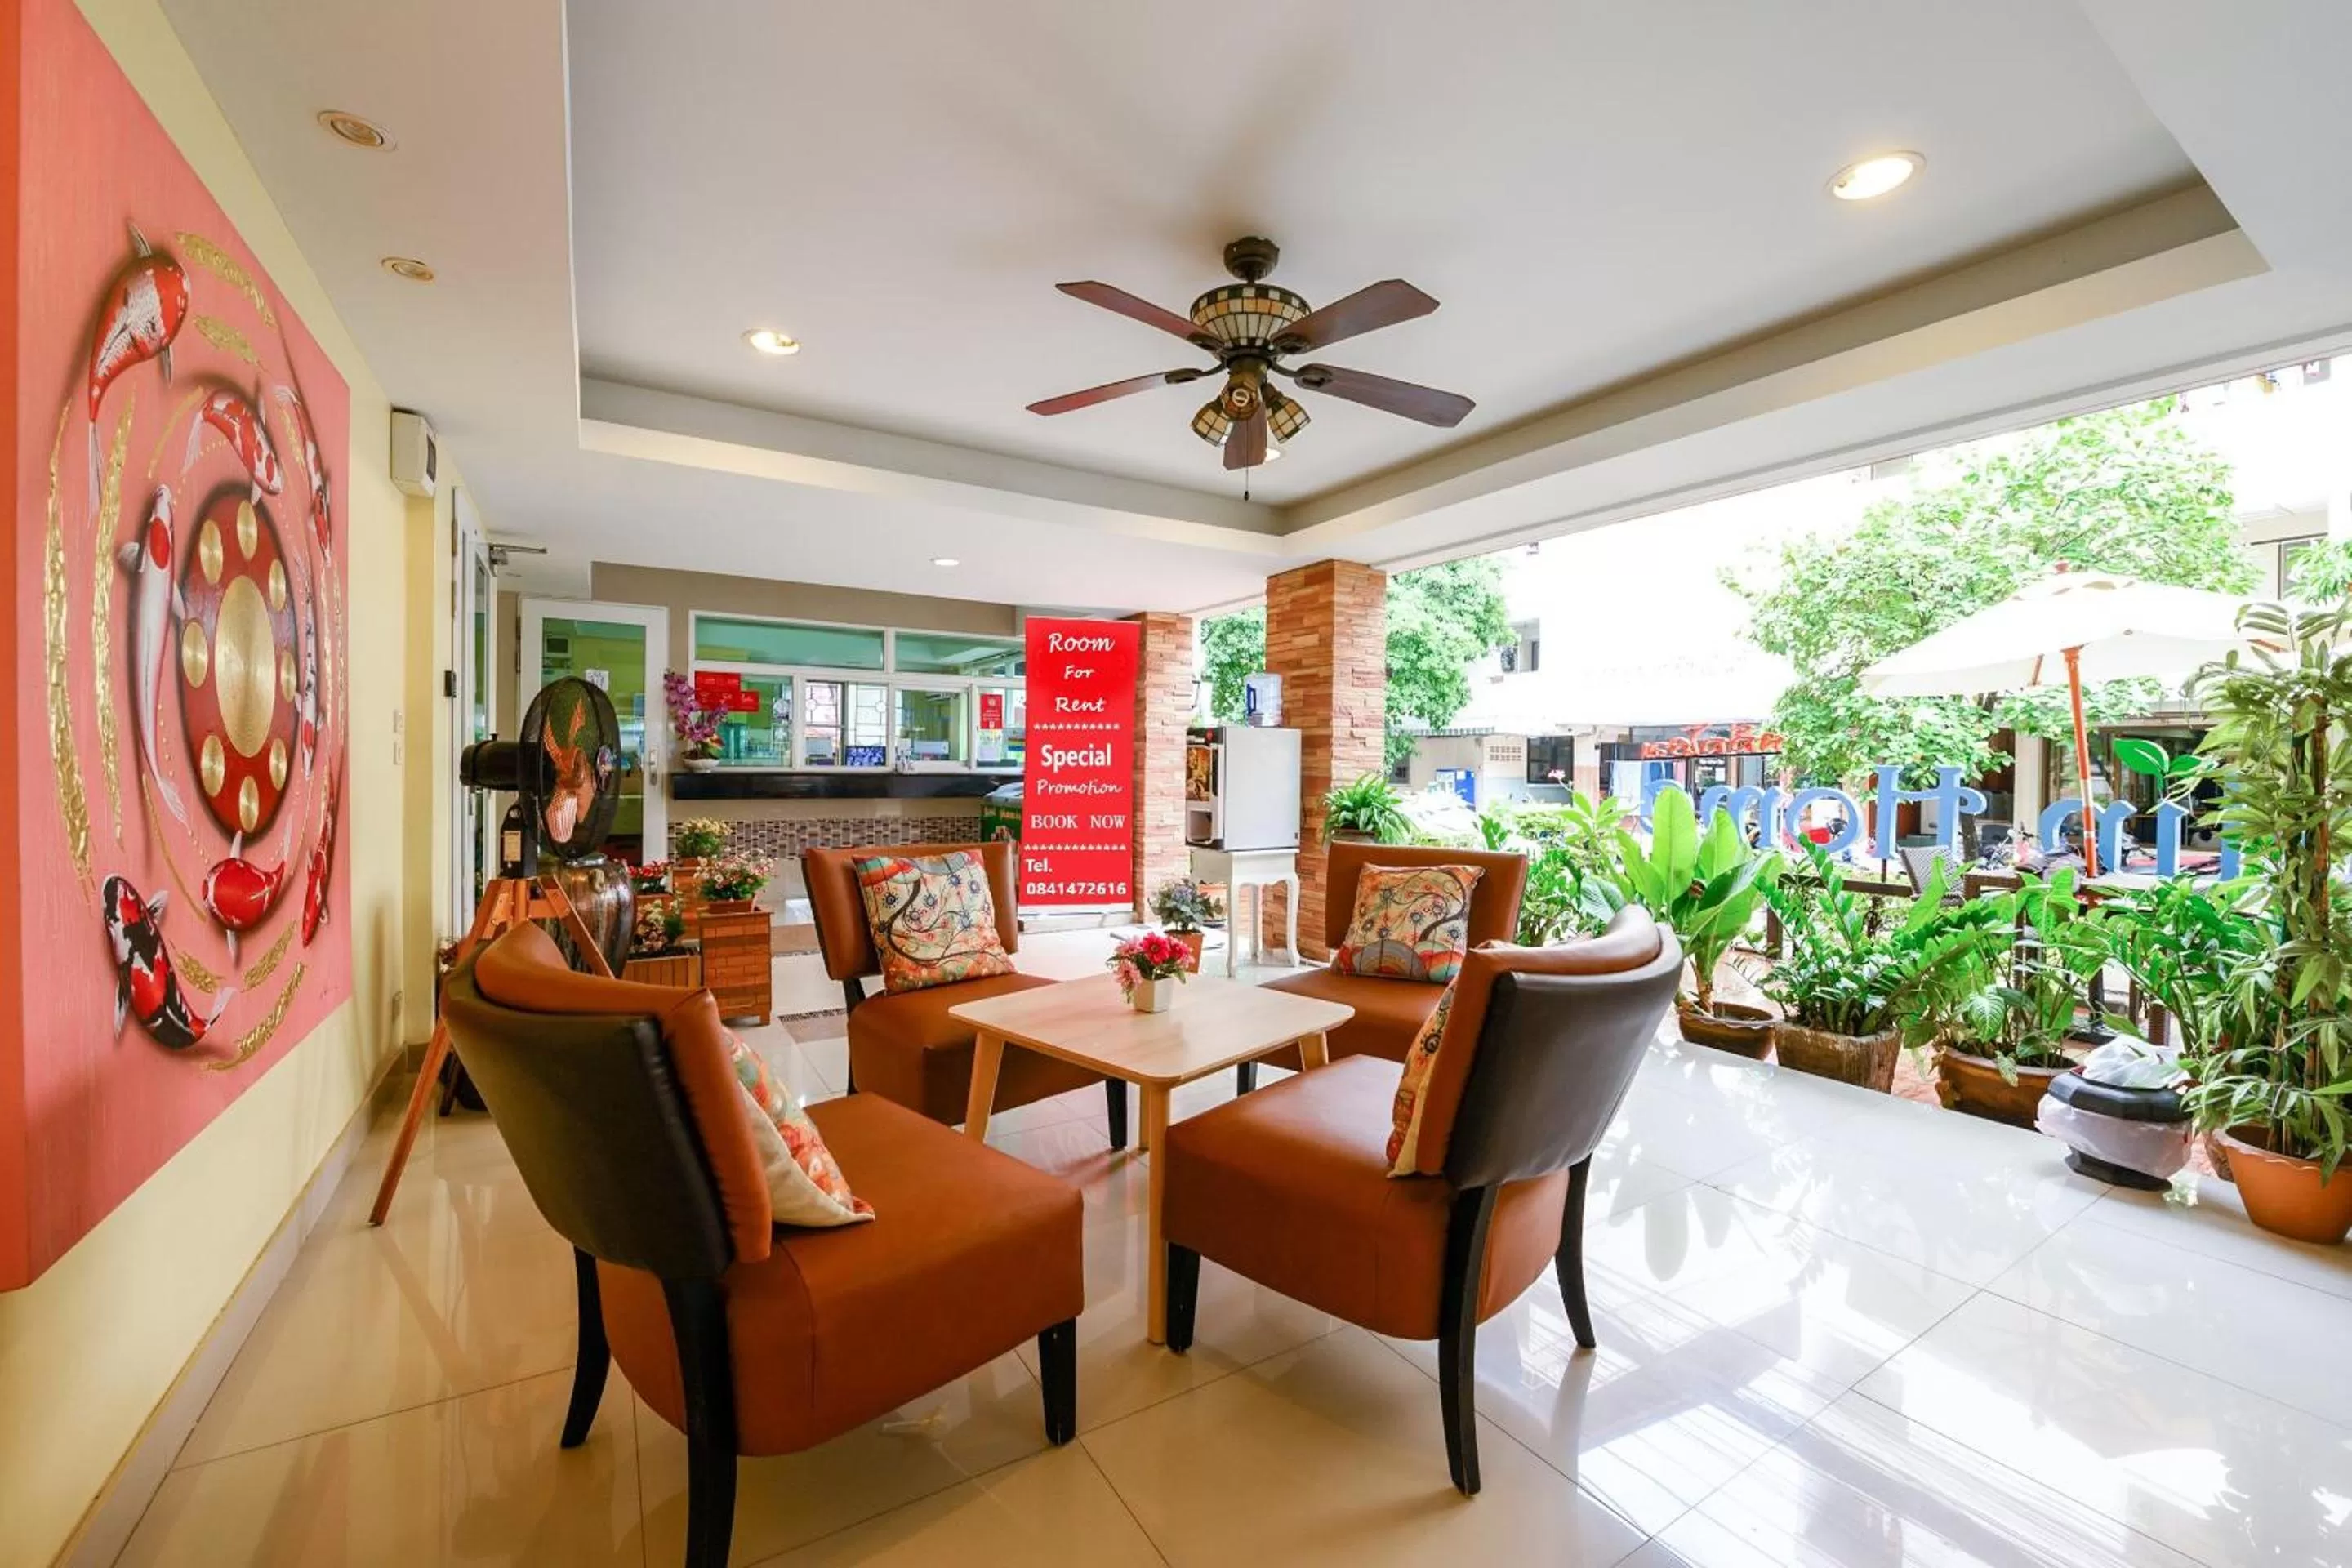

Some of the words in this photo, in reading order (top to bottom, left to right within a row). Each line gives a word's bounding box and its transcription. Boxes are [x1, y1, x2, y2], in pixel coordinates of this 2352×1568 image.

[1048, 632, 1116, 653] Room
[1064, 665, 1094, 679] For
[1055, 697, 1106, 713] Rent
[1040, 742, 1111, 773] Special
[1036, 778, 1123, 795] Promotion
[1031, 814, 1078, 829] BOOK
[1090, 814, 1125, 829] NOW
[1025, 858, 1053, 873] Tel.
[1026, 881, 1127, 895] 0841472616
